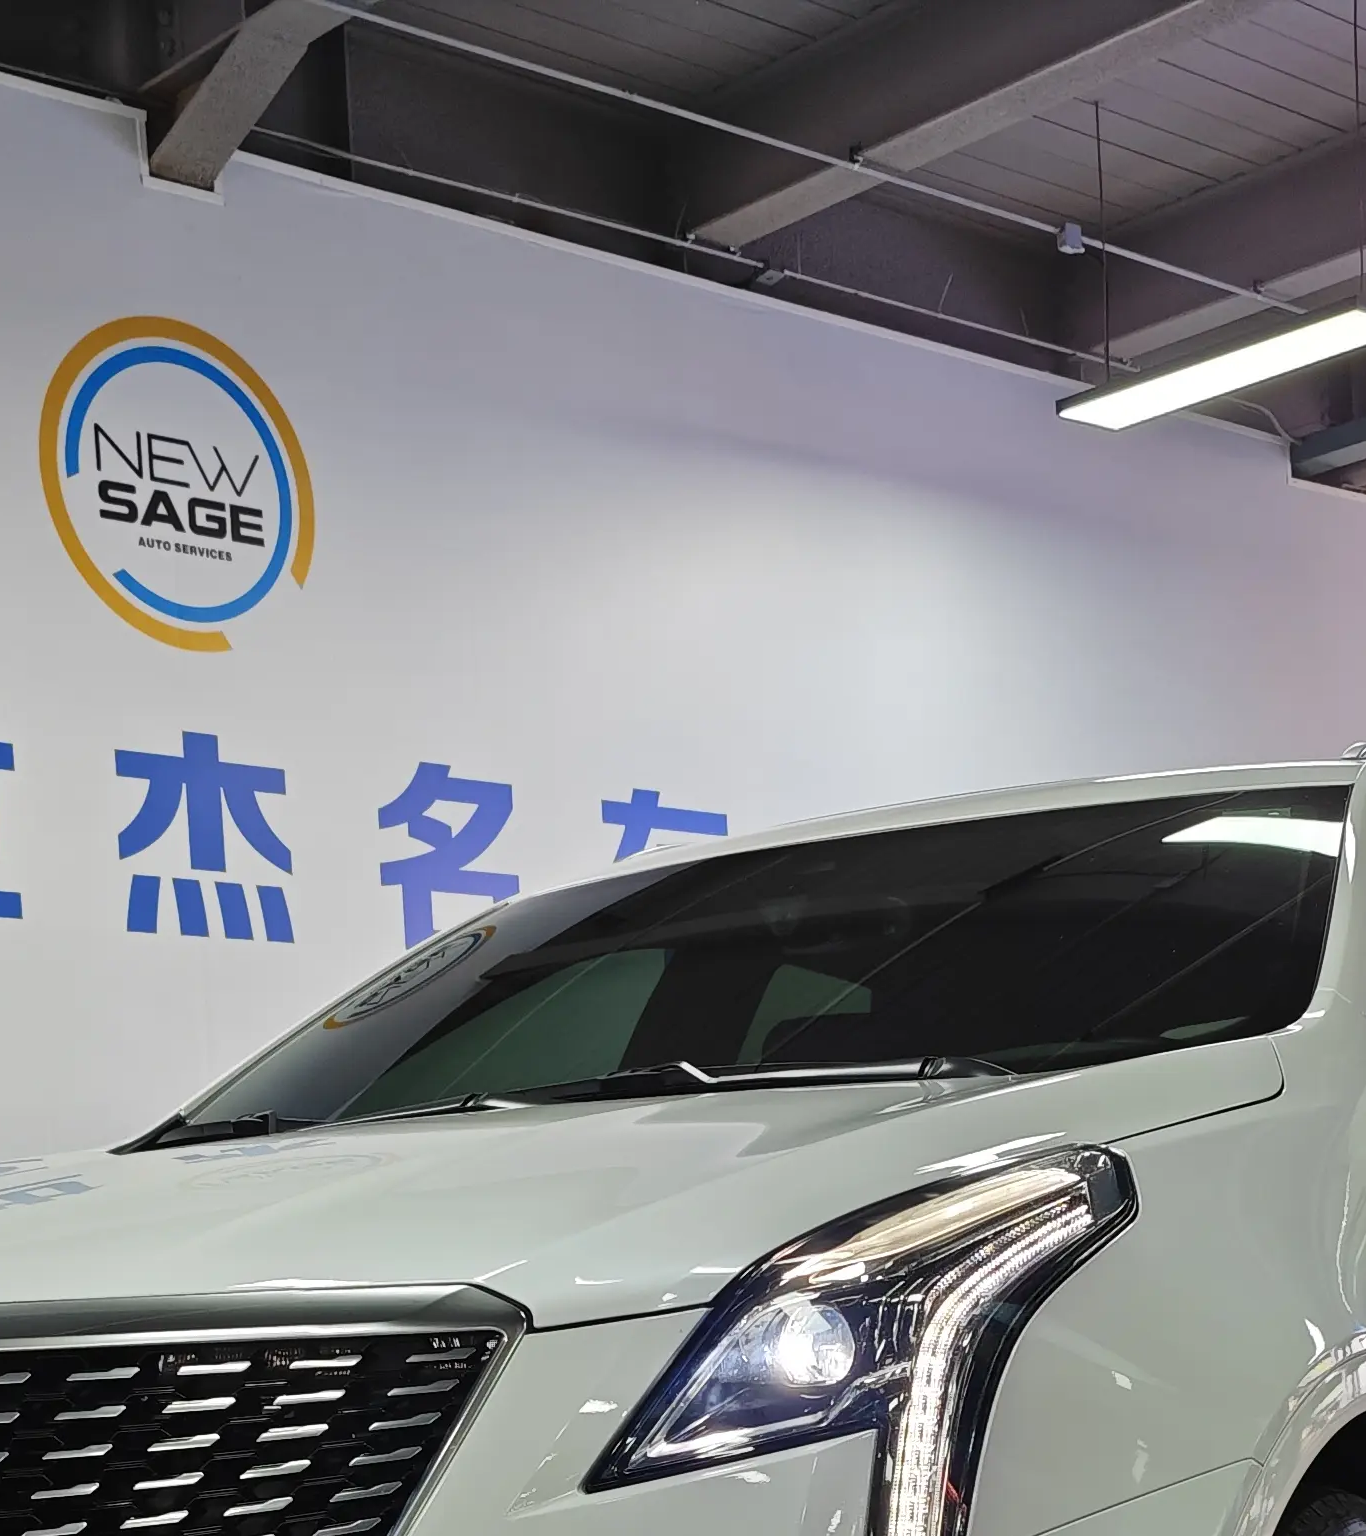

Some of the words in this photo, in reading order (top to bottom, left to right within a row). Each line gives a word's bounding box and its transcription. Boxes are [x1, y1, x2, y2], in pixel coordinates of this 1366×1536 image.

[93, 422, 260, 498] NEW
[97, 478, 266, 548] SAGE
[138, 535, 172, 552] AUTO
[174, 541, 234, 563] SERVICES
